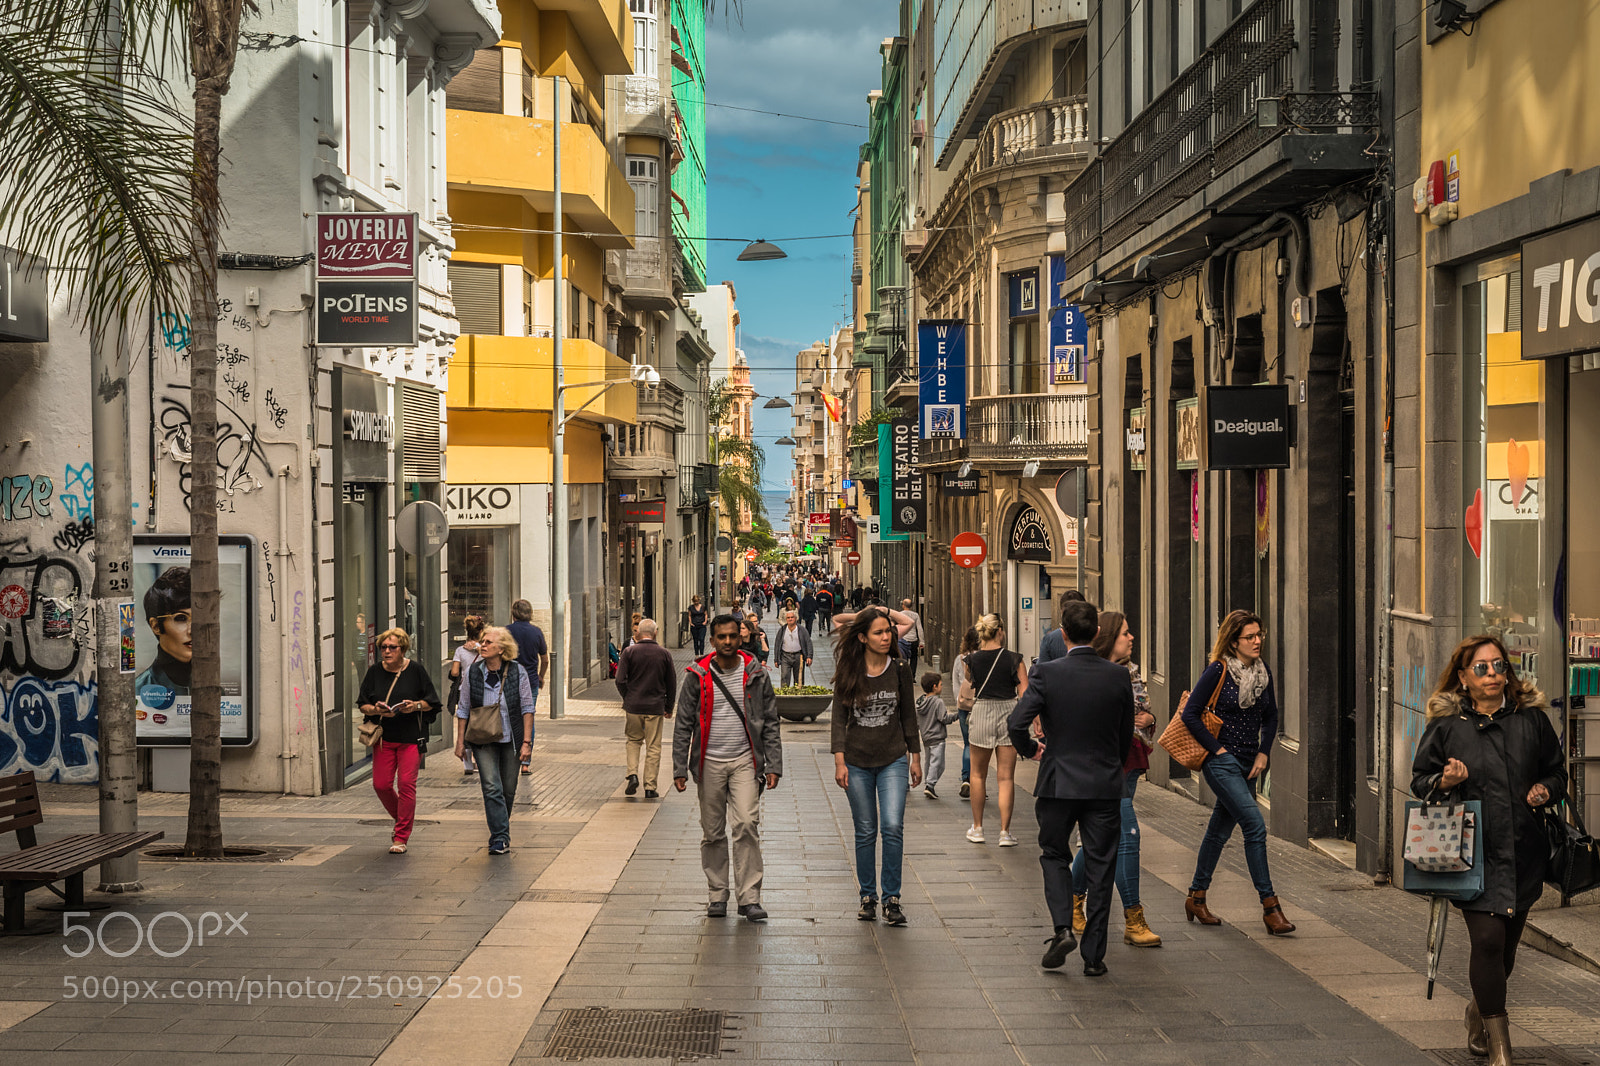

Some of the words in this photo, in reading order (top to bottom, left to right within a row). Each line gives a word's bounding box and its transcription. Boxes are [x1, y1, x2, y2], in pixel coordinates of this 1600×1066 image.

[324, 218, 408, 240] JOYERIA
[321, 240, 409, 260] MENA
[323, 293, 408, 313] POTENS
[371, 315, 389, 323] TIME
[936, 325, 948, 403] WEHBE
[350, 410, 396, 443] SPRINGFIELD
[895, 425, 909, 480] TEATRO
[895, 483, 909, 500] EL
[911, 478, 922, 500] DEL
